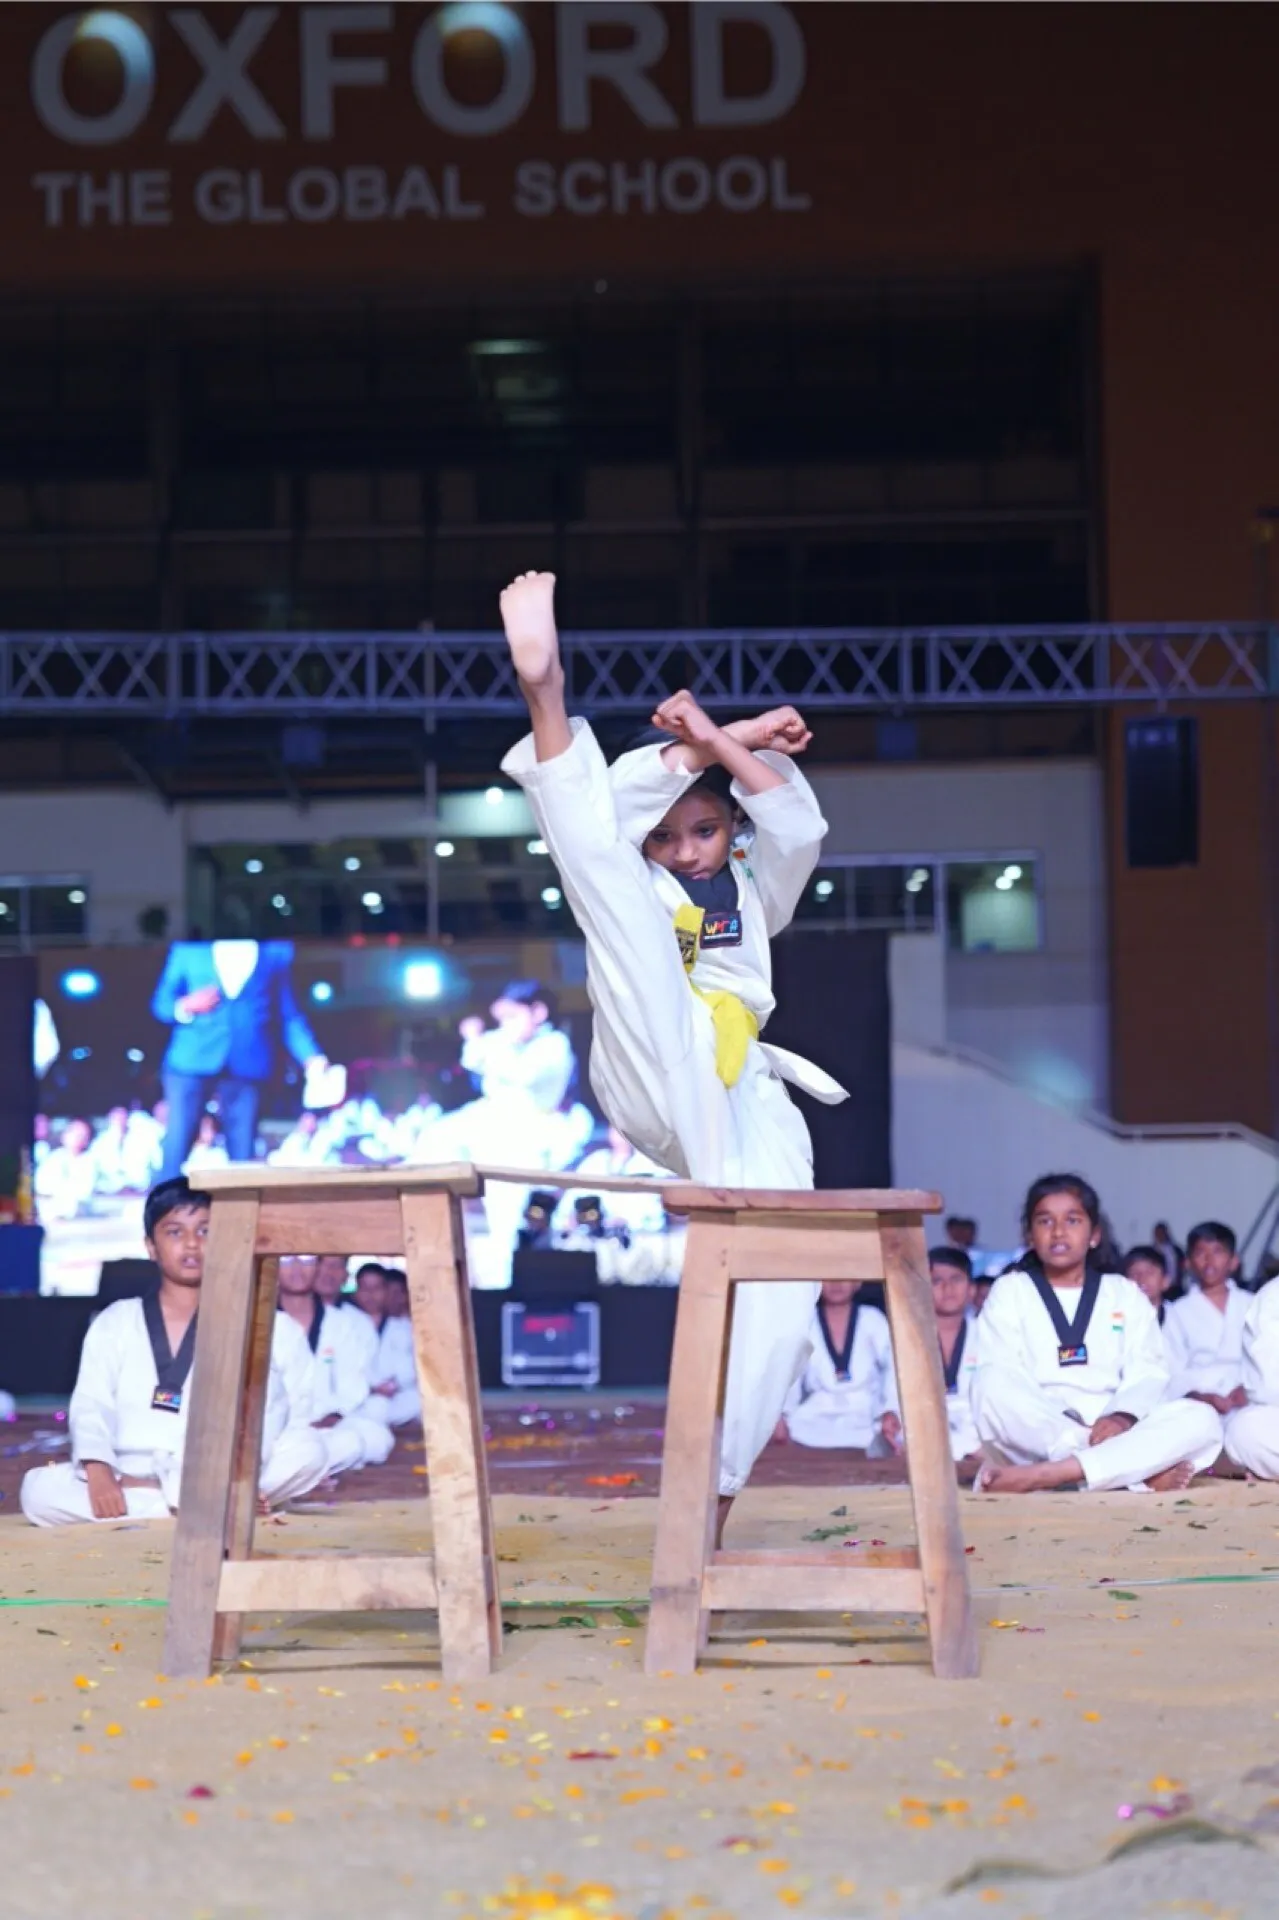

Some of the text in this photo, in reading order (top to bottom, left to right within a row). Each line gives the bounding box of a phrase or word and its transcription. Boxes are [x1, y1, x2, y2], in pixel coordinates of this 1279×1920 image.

[30, 1, 808, 144] OXFORD
[33, 157, 812, 227] THE GLOBAL SCHOOL
